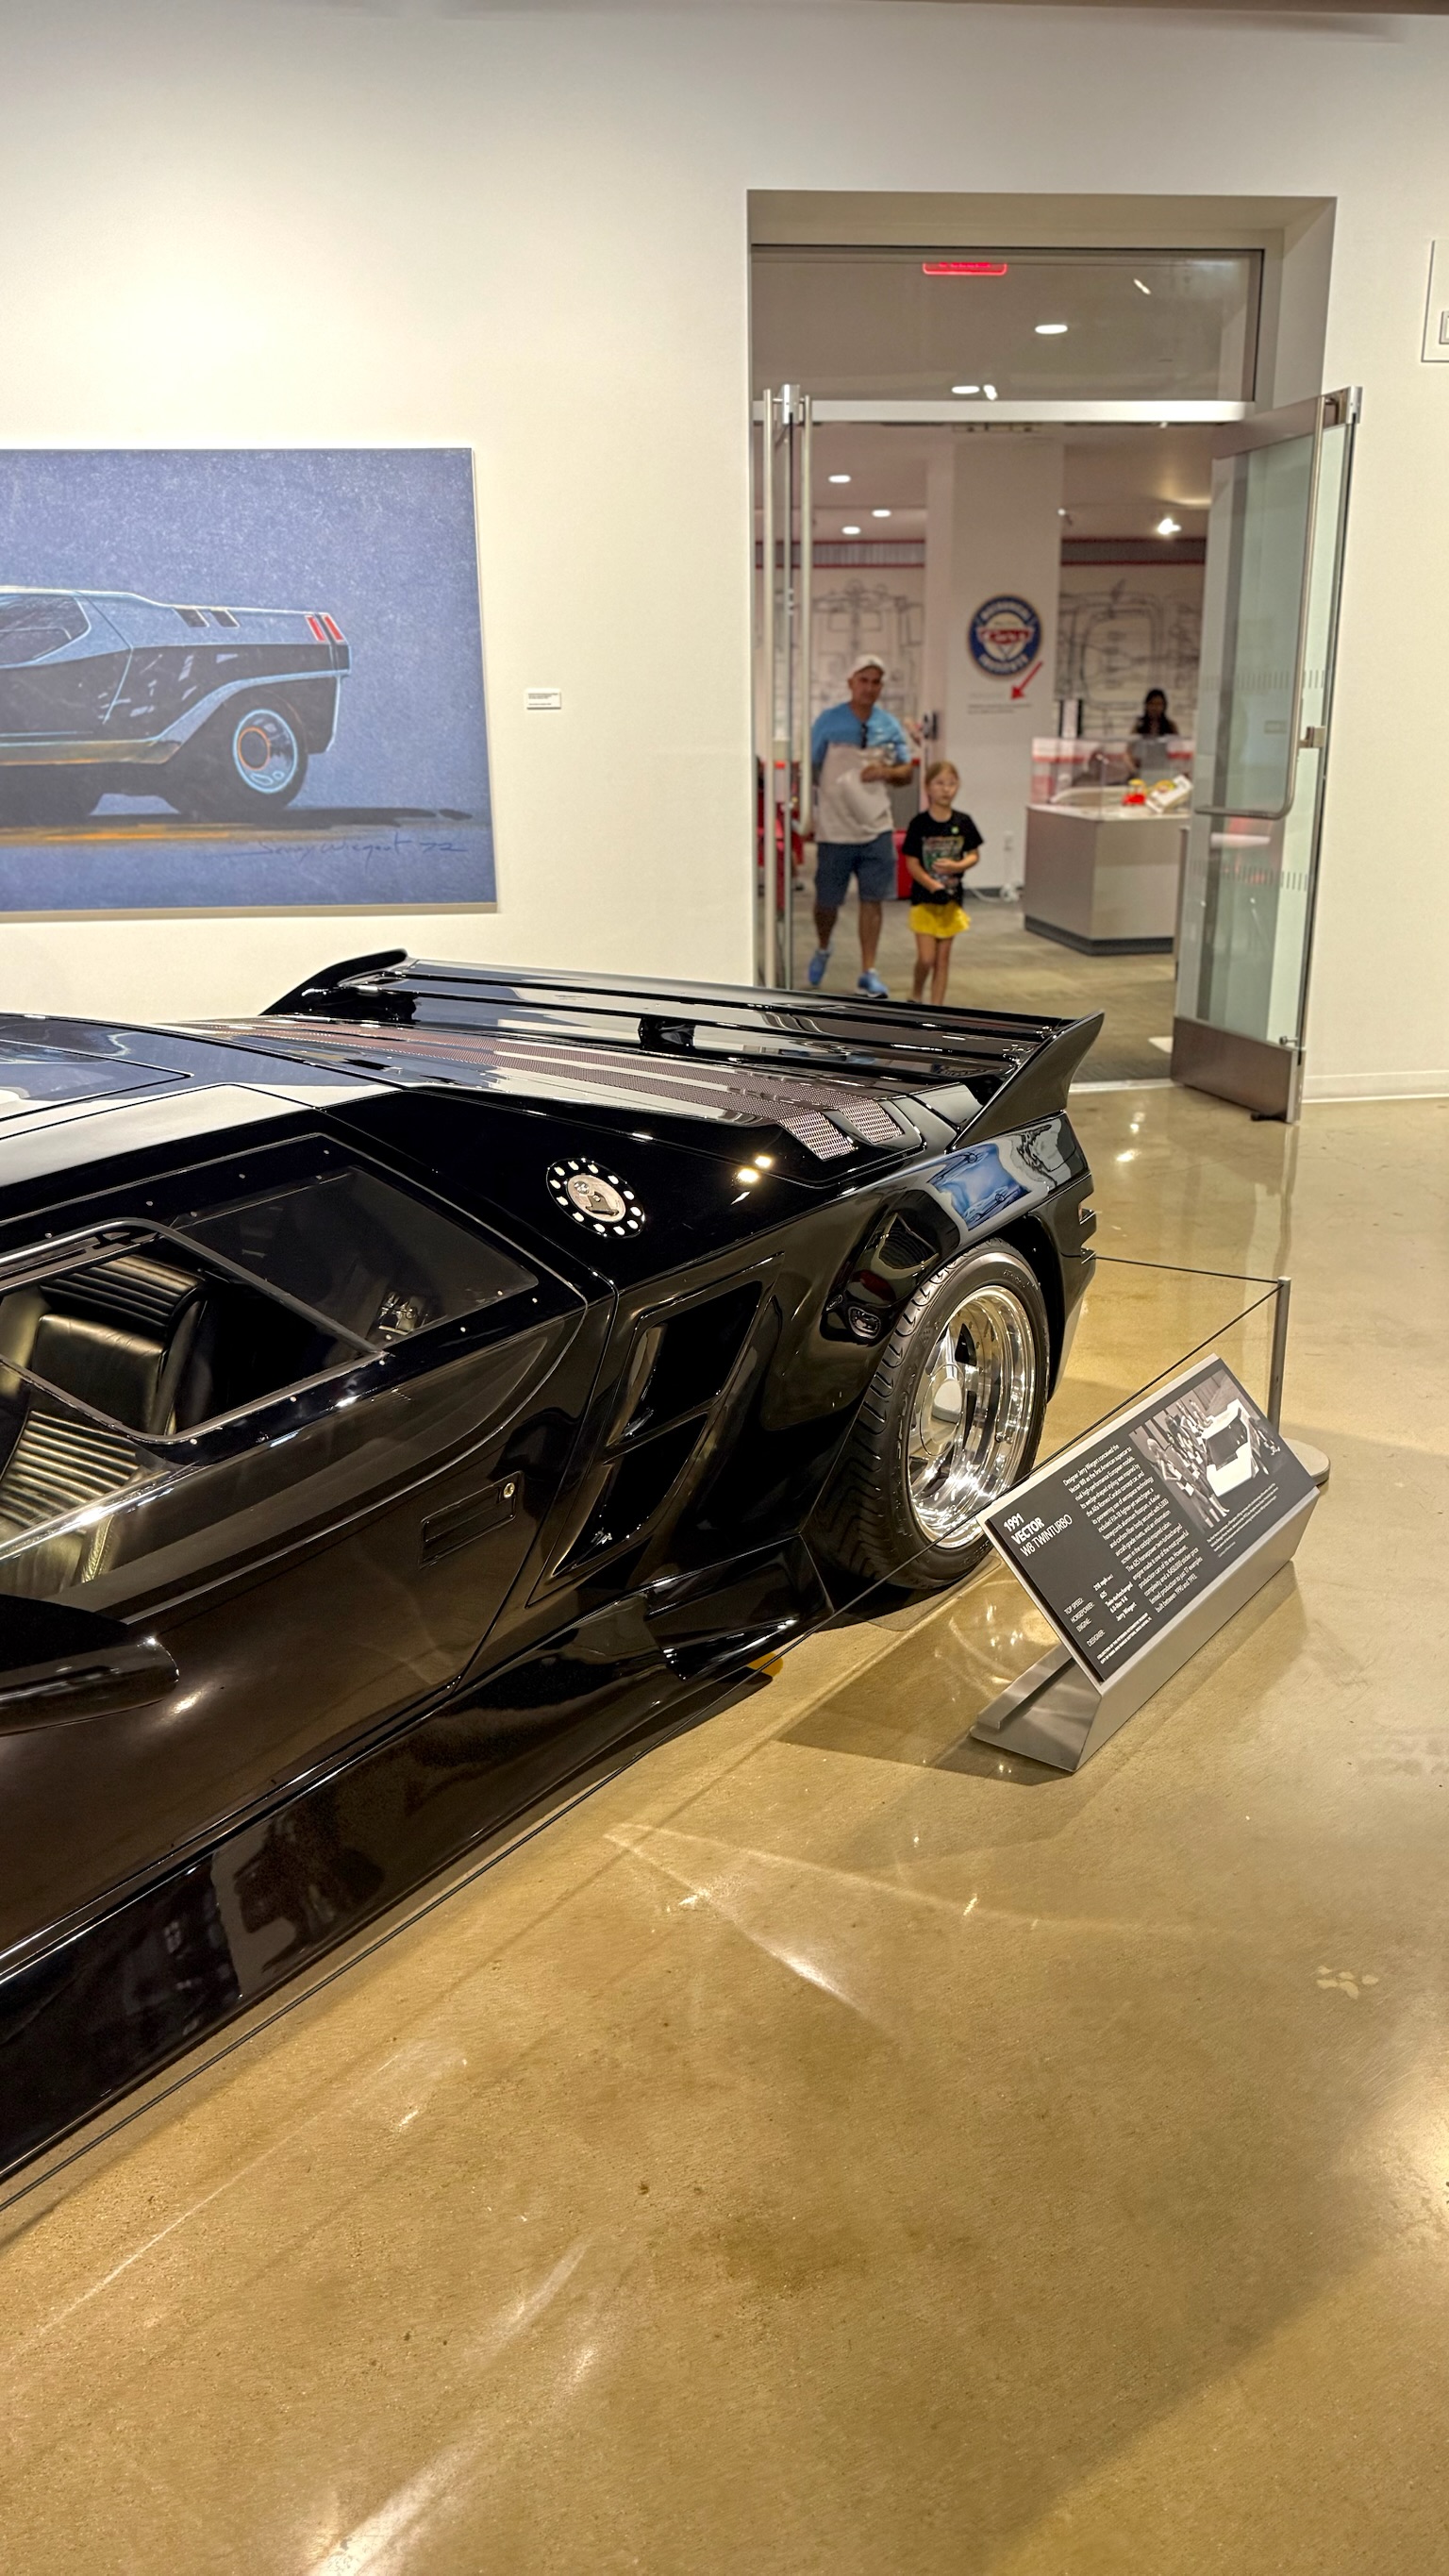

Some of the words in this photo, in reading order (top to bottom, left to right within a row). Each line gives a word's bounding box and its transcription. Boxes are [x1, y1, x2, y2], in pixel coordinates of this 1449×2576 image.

[1004, 1514, 1024, 1531] 1991
[1011, 1517, 1044, 1544] VECTOR
[1020, 1542, 1036, 1556] W8
[1032, 1514, 1072, 1547] TWINTURBO
